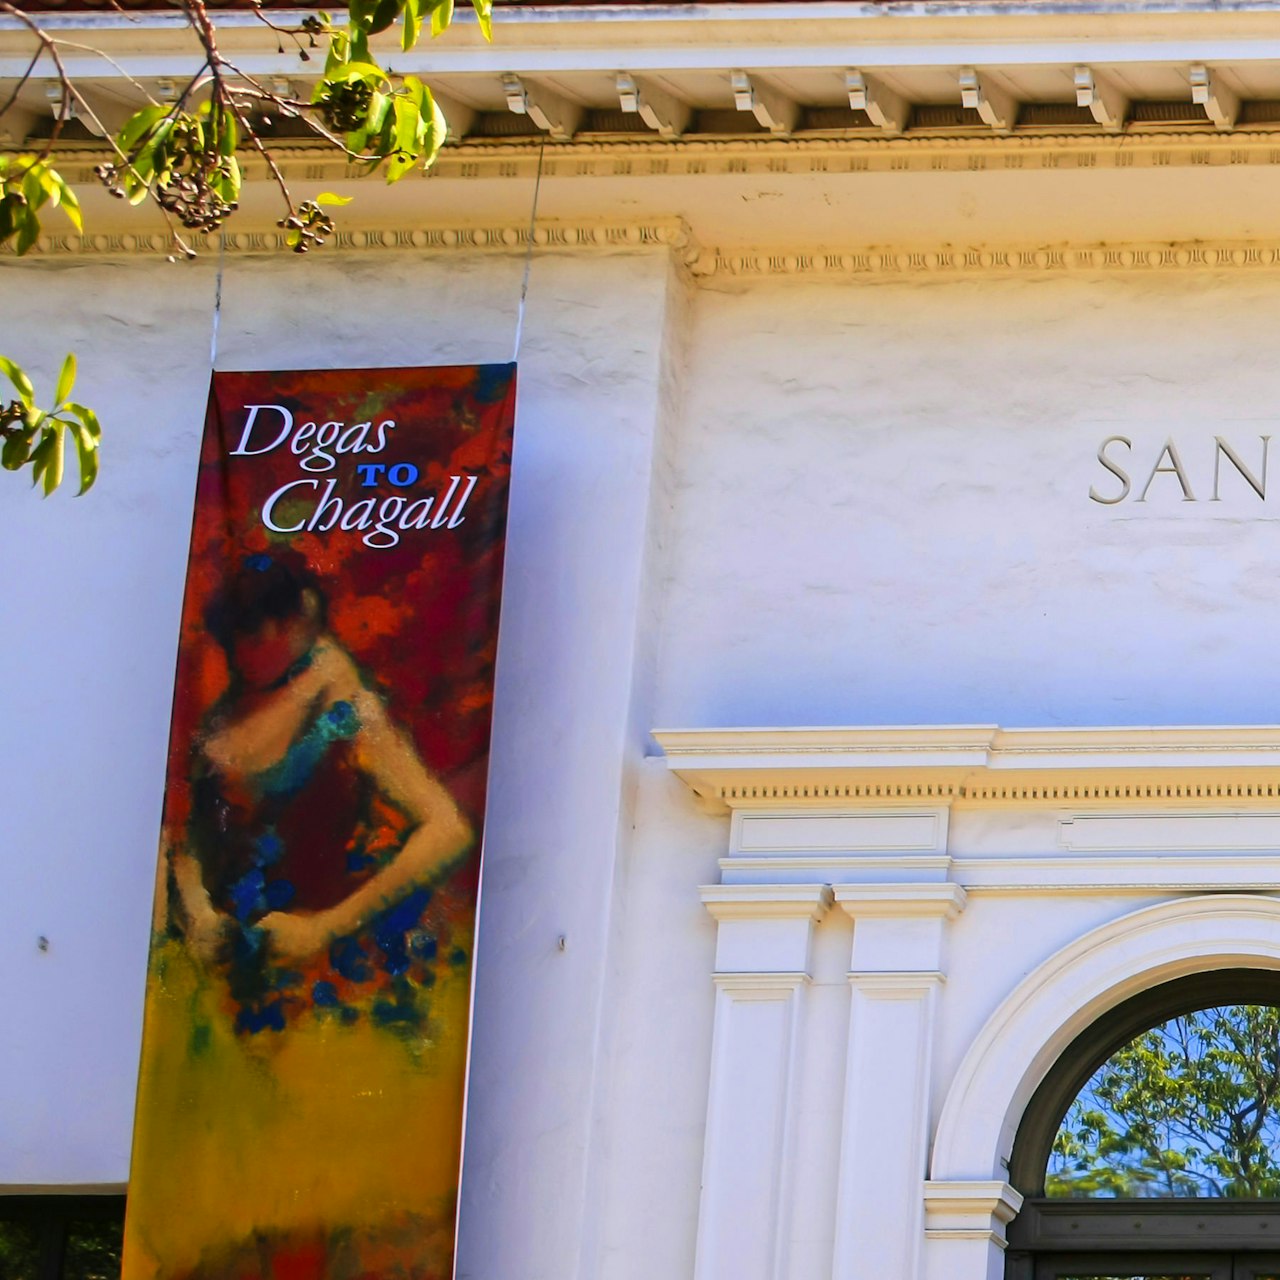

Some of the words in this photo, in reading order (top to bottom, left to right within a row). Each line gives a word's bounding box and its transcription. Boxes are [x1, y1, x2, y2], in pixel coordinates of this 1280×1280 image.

[229, 404, 395, 472] Degas
[357, 463, 418, 487] TO
[261, 475, 478, 548] Chagall
